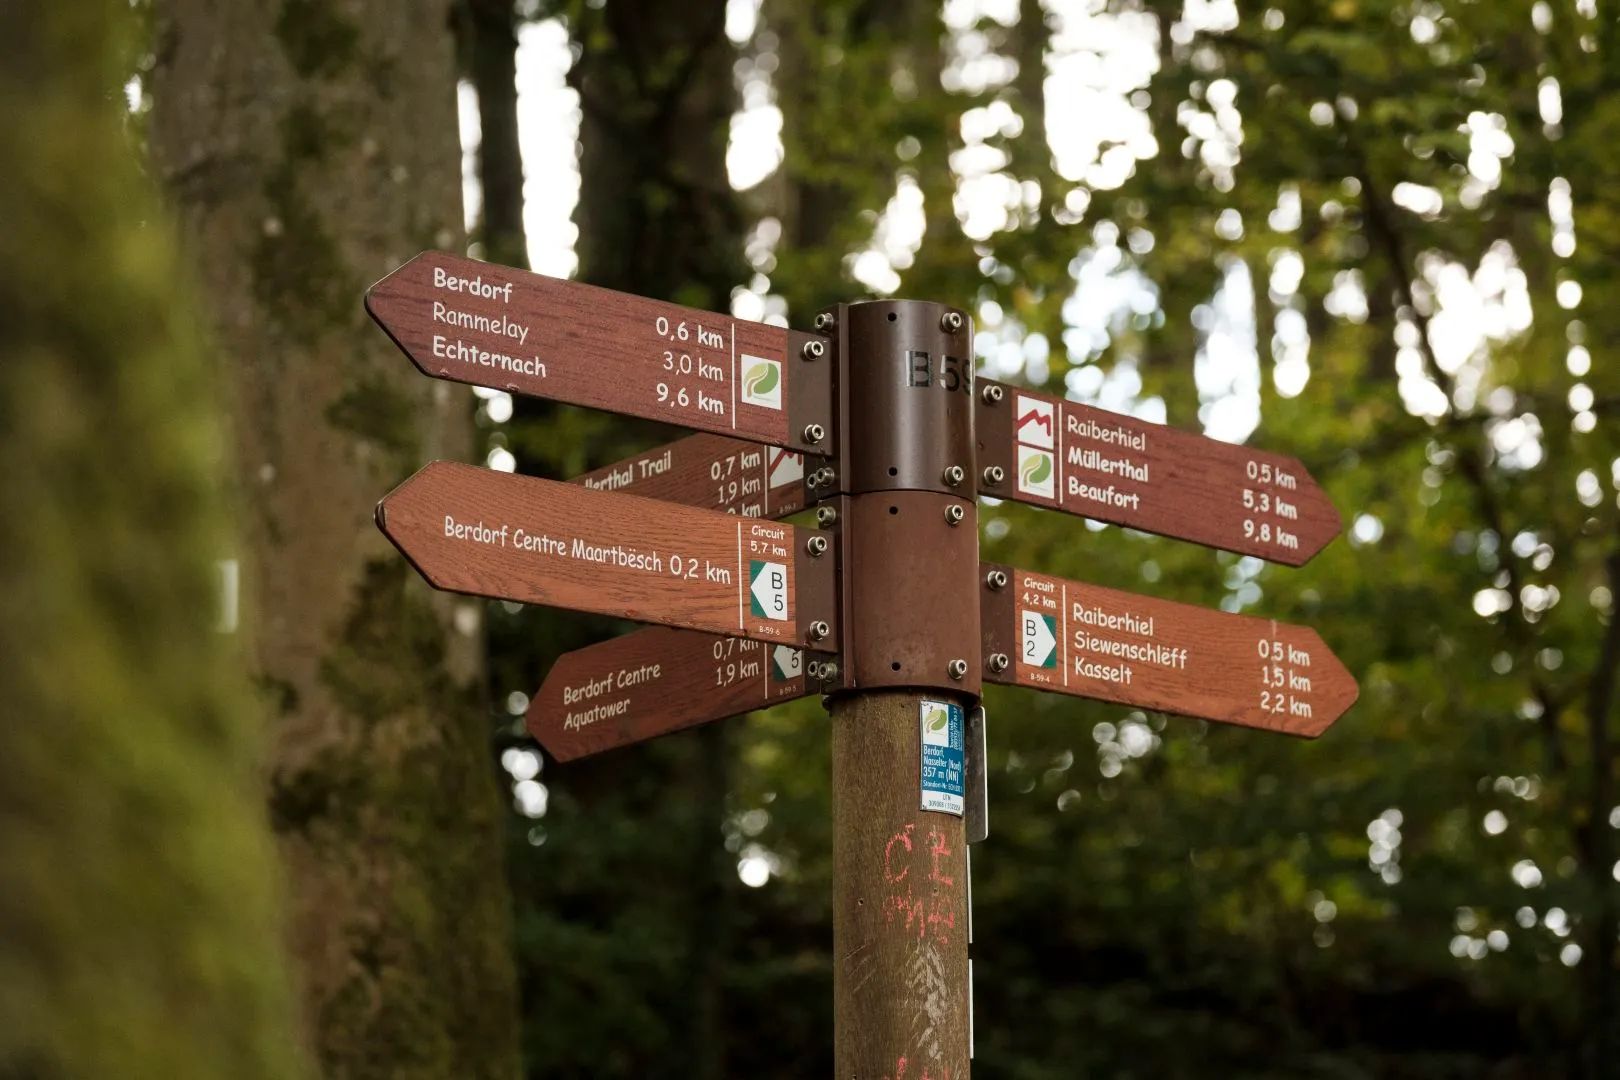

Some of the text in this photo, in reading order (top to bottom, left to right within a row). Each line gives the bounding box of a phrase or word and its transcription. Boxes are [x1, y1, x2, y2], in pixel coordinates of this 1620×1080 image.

[434, 267, 724, 348] Berdorf 0,6 km
[433, 301, 724, 382] Rammelay 3,0 km
[433, 336, 724, 414] Echternach 9,6 km
[905, 350, 933, 387] B
[638, 450, 672, 478] Trail
[710, 452, 760, 480] 0,7 km
[1068, 414, 1296, 490] Raiberhiel 0,5 km
[718, 477, 760, 504] 1,9 km
[1068, 446, 1298, 520] Müllerthal 5,3 km
[742, 504, 761, 518] km
[1068, 477, 1298, 550] Beaufort 9,8 km
[752, 525, 784, 540] Circuit
[444, 516, 731, 585] Berdorf Centre Maartbësch 0,2 km
[750, 540, 787, 557] 5,7 km
[772, 572, 783, 590] B
[1024, 577, 1054, 593] Circuit
[774, 594, 784, 612] 5
[1022, 593, 1056, 610] 4,2 km
[1026, 620, 1036, 636] B
[1072, 603, 1154, 636] Raiberhiel
[1288, 644, 1310, 666] km
[792, 652, 799, 668] 5
[1026, 640, 1036, 657] 2
[1074, 631, 1311, 692] Siewenschlëff 1,5 km
[562, 673, 614, 706] Berdorf
[617, 662, 662, 690] Centre
[714, 638, 736, 661] 0,7
[563, 660, 759, 733] Aquatower 1,9 km
[1075, 656, 1312, 718] Kasselt 2,2 km
[923, 766, 936, 778] 357
